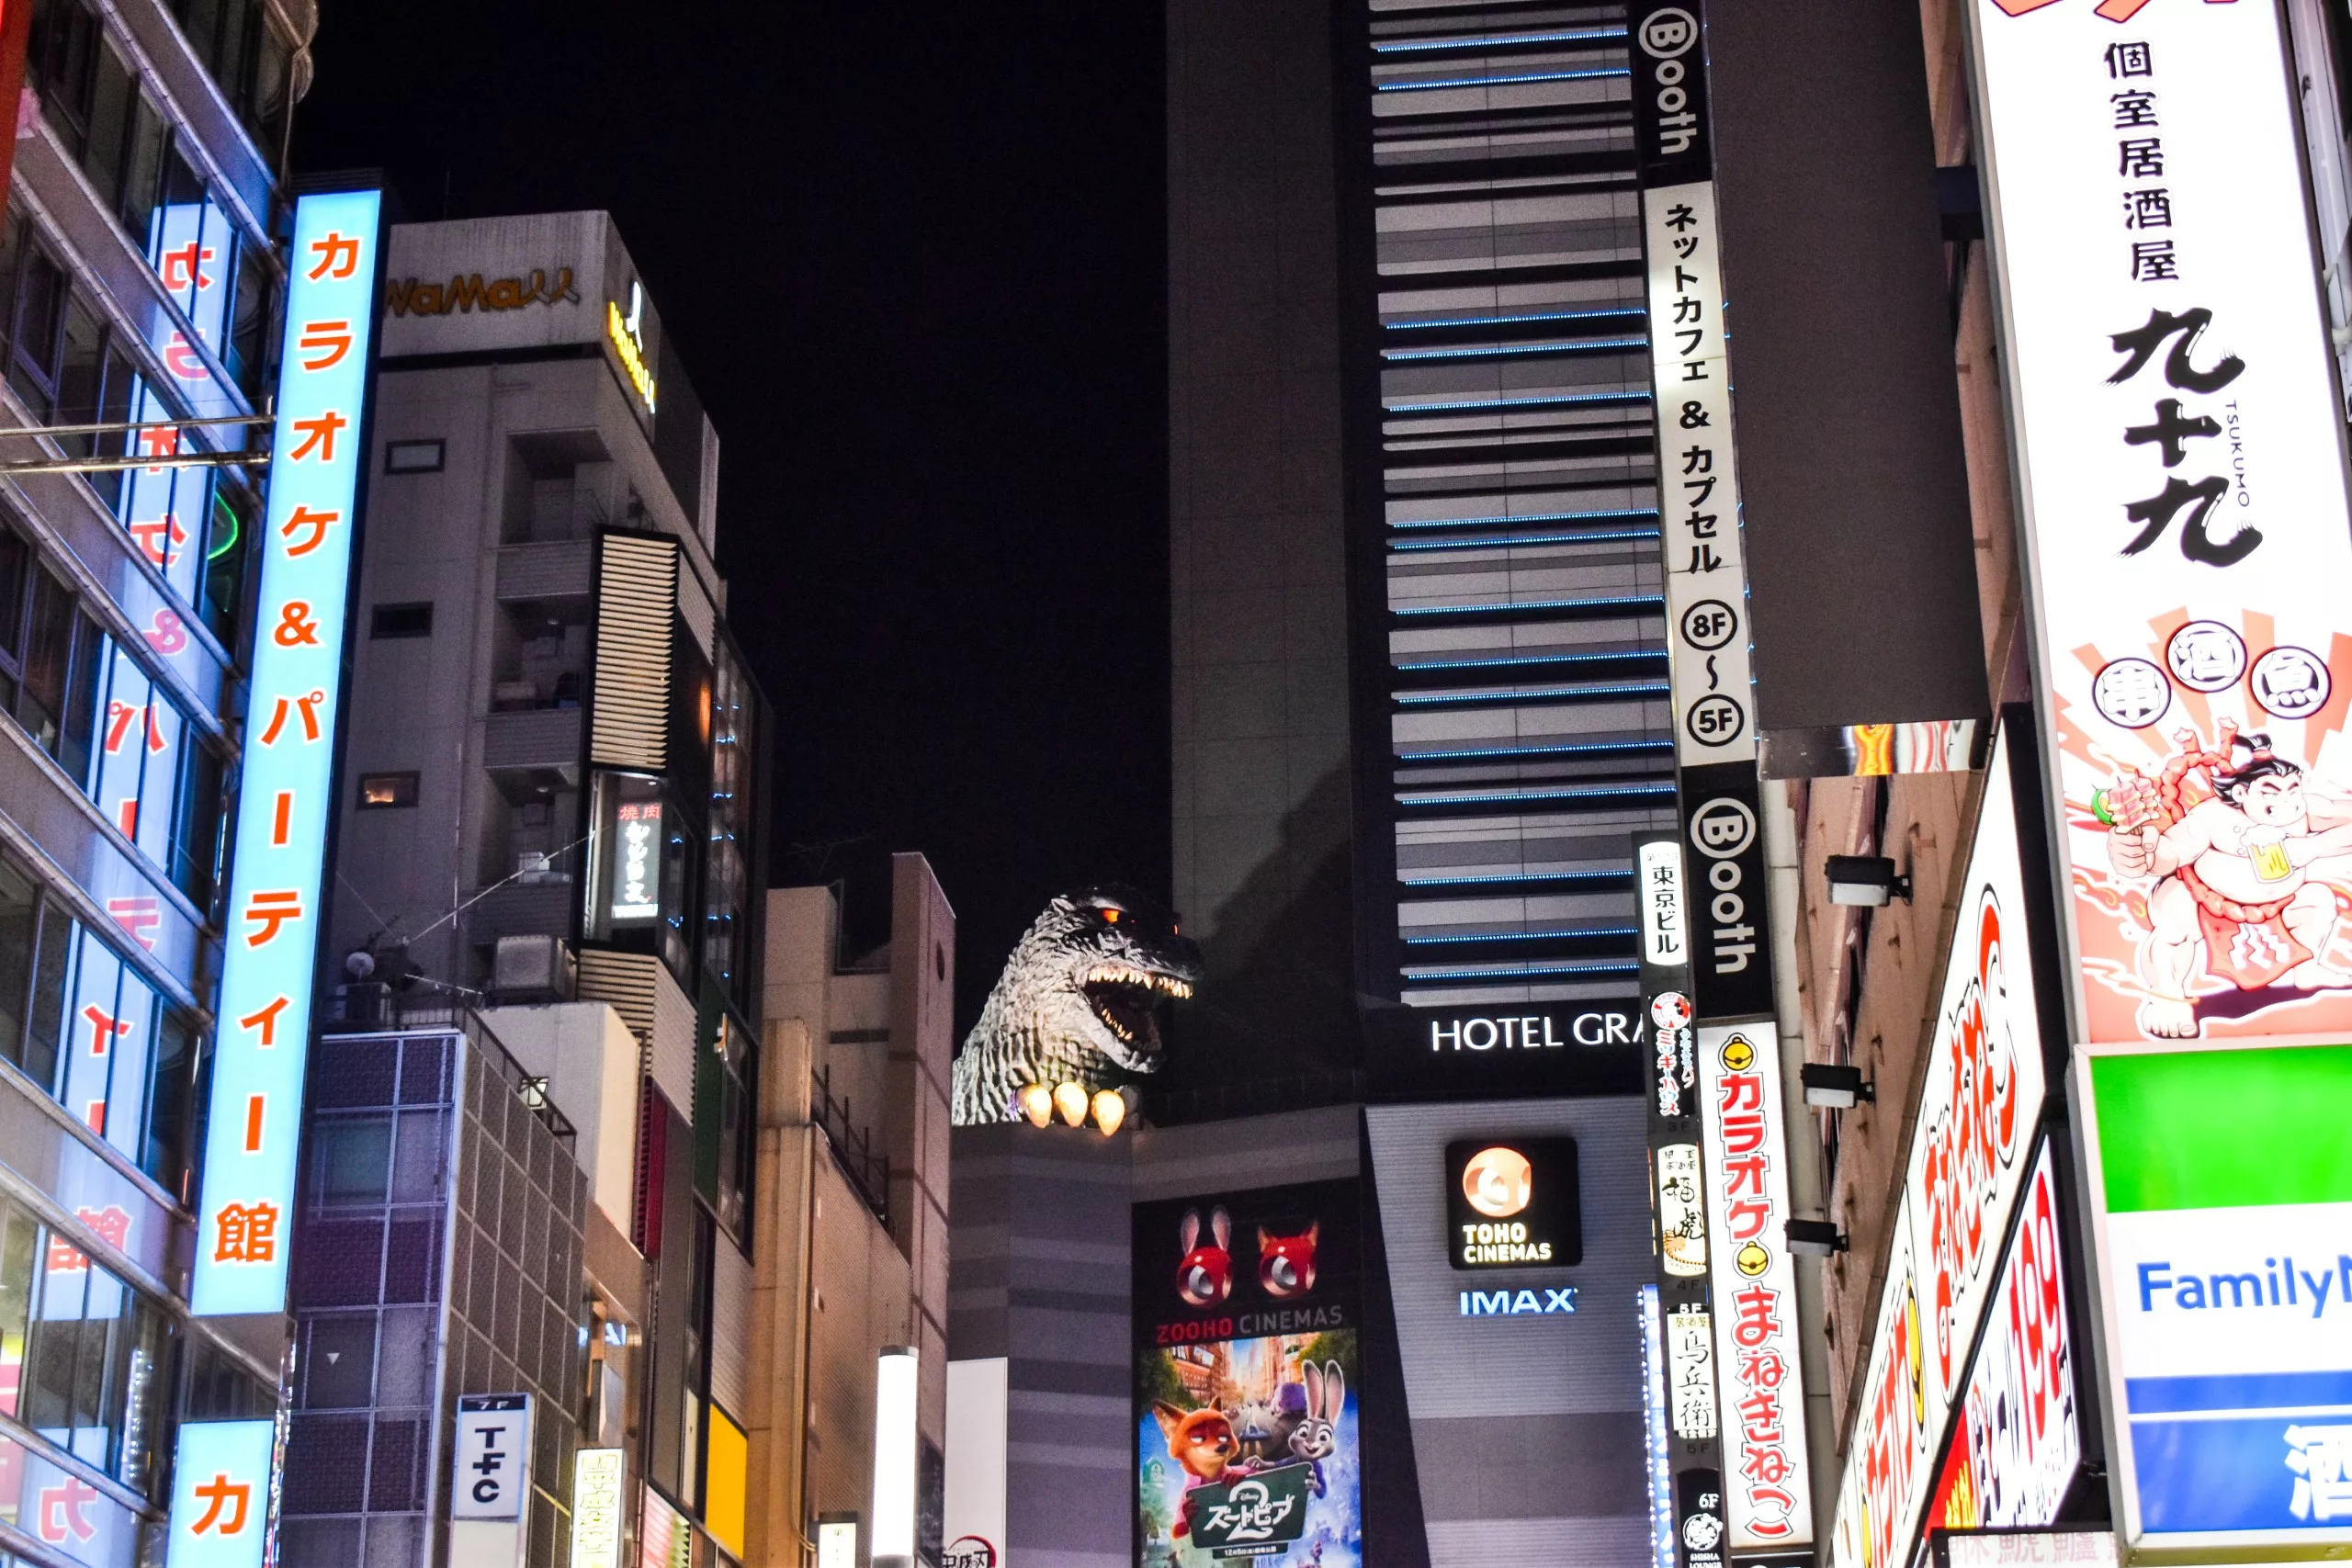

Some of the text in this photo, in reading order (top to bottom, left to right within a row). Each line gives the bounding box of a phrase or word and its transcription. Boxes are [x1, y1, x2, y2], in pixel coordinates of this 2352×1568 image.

[1638, 7, 1698, 154] Booth
[2104, 39, 2179, 283] 個室居酒屋
[2099, 307, 2264, 568] 九十九
[2224, 399, 2251, 509] TSUKUMO
[213, 231, 360, 1264] カラオケ&パーティー館
[1690, 797, 1757, 974] Booth
[1431, 1016, 1565, 1052] HOTEL
[1716, 1071, 1771, 1244] カラオケ
[1463, 1223, 1527, 1244] TOHO
[1464, 1243, 1552, 1263] CINEMAS
[1156, 1305, 1343, 1346] ZOOHO CINEMAS
[1460, 1288, 1576, 1315] IMAX
[478, 1401, 509, 1410] 7F
[1733, 1284, 1797, 1537] まねきねこ
[190, 1473, 251, 1536] カ
[1204, 1494, 1295, 1531] ズートピア
[1699, 1494, 1719, 1508] 6F
